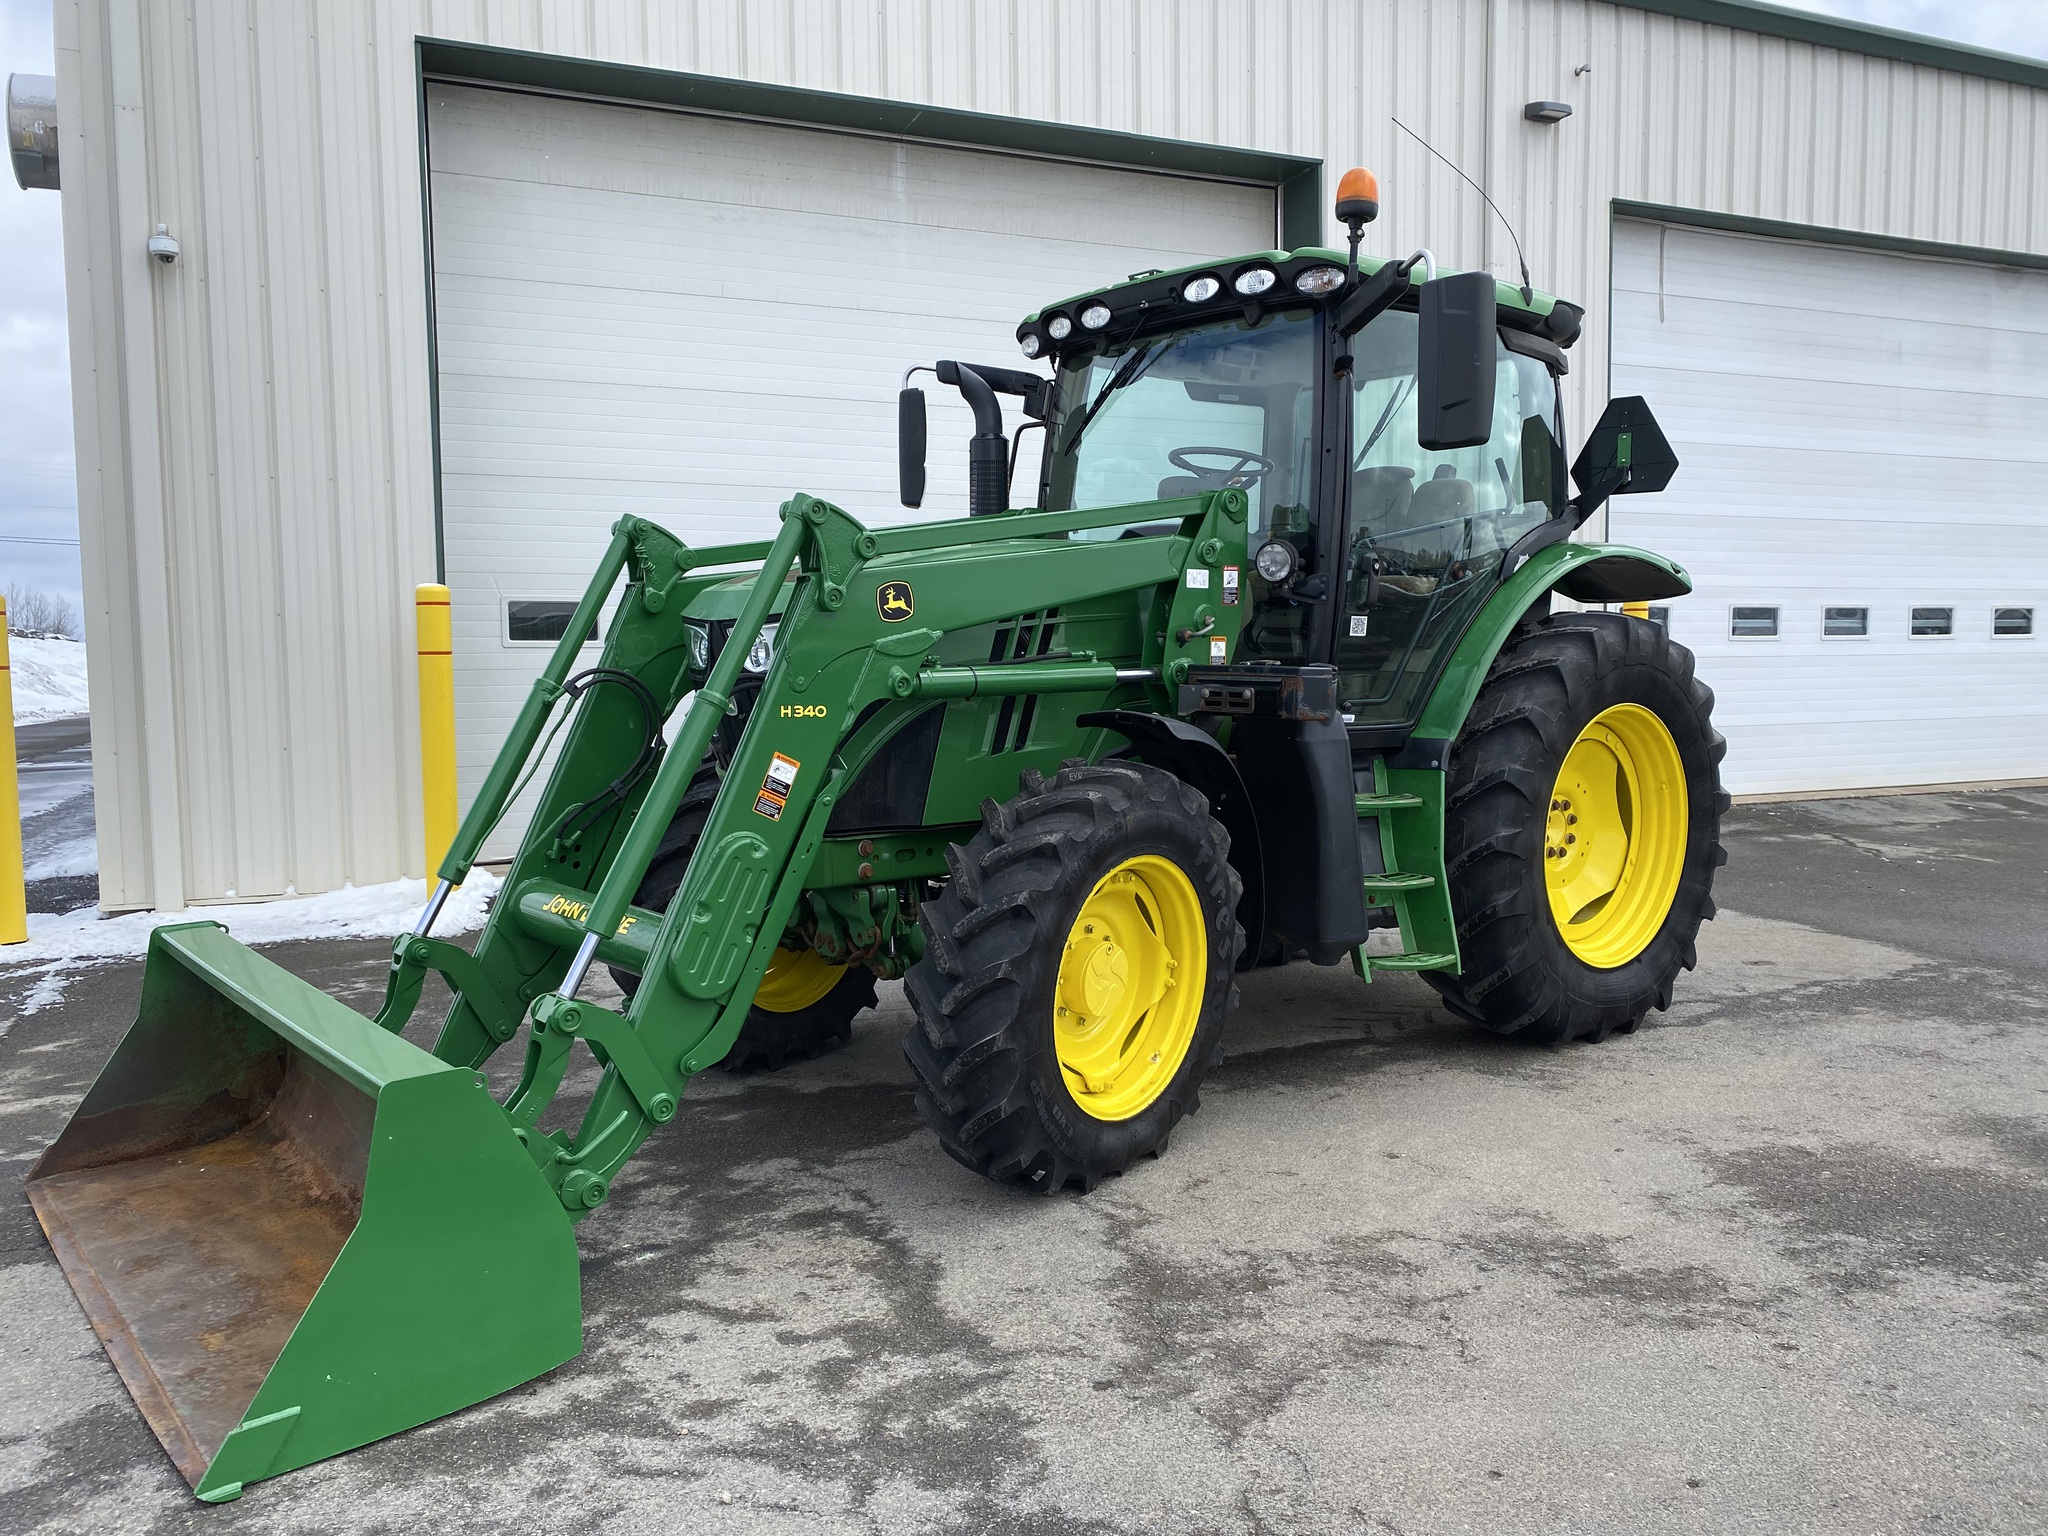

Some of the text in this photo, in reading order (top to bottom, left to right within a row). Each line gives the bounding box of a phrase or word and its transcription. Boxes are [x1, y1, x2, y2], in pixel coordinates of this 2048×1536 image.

[780, 705, 827, 718] H340
[542, 894, 587, 920] JOHN
[1052, 1104, 1074, 1138] EVO
